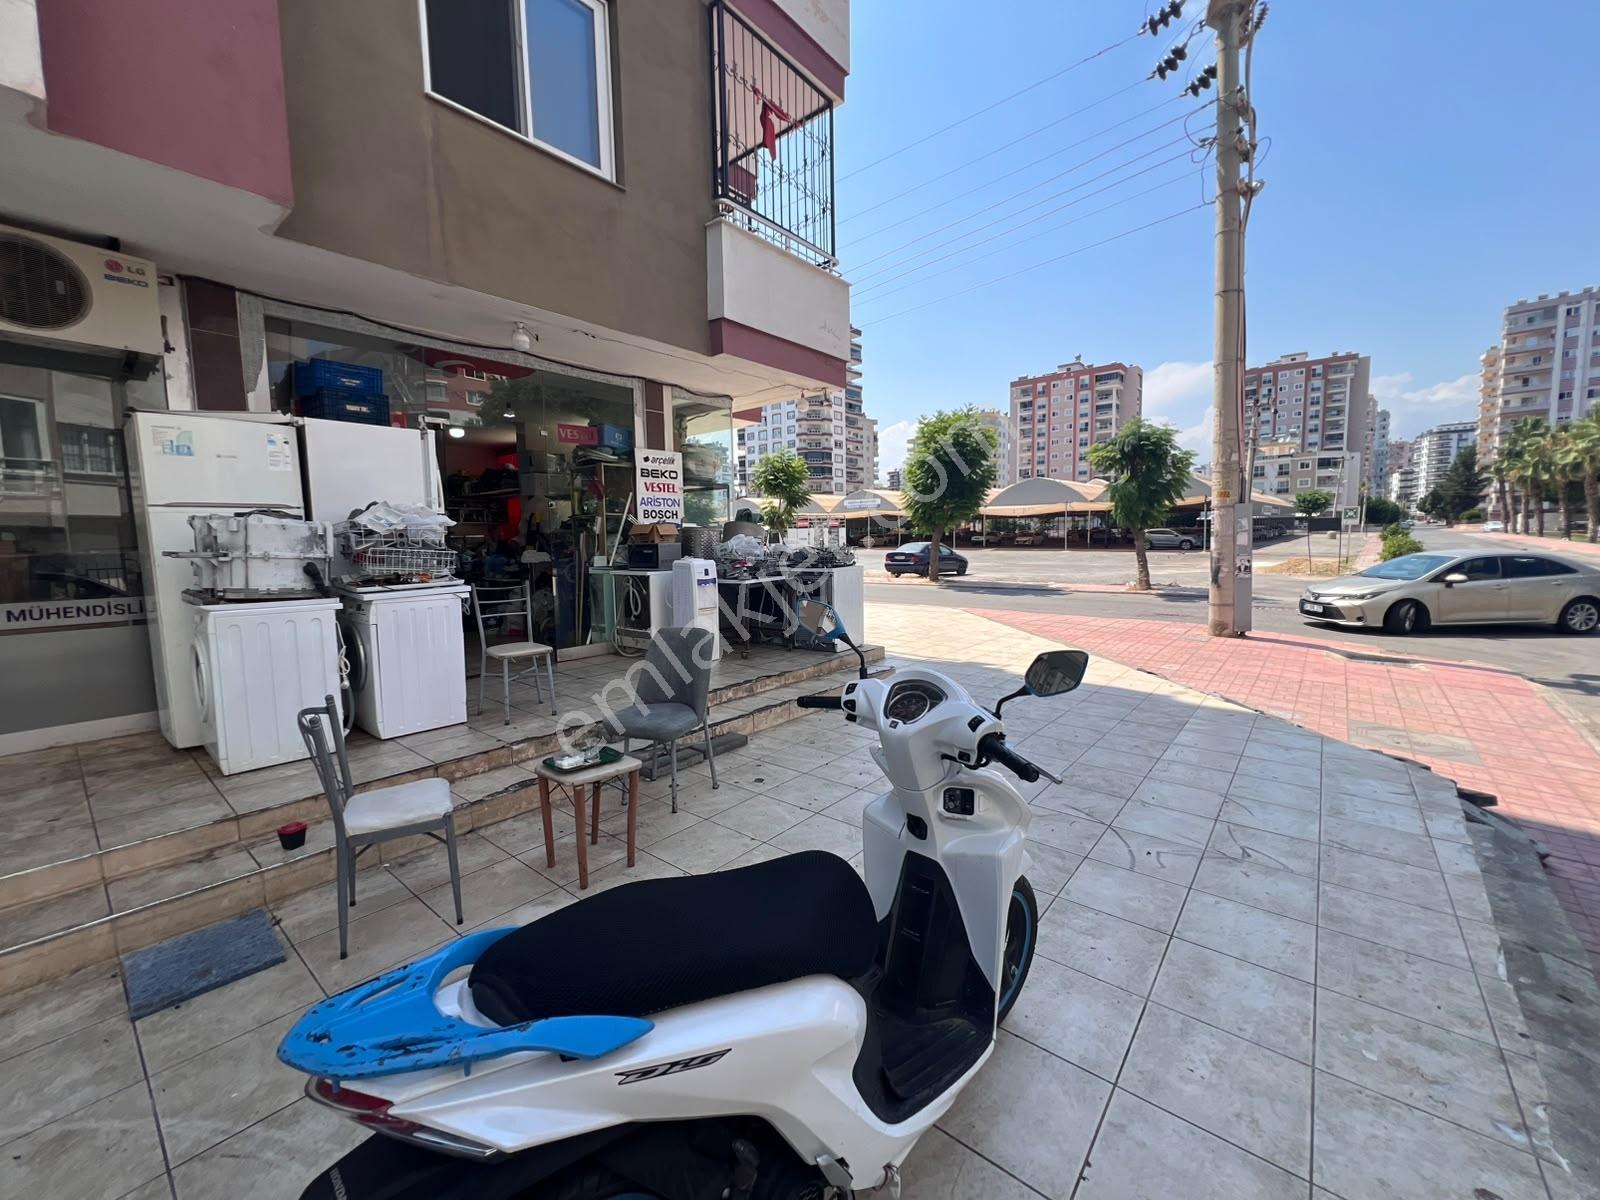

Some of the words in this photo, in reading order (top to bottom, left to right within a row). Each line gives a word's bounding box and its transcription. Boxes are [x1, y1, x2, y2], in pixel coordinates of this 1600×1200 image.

[127, 265, 146, 276] LG
[651, 456, 675, 465] arçelik
[640, 468, 678, 480] BEKO
[644, 482, 678, 493] VESTEL
[643, 509, 679, 519] BOSCH
